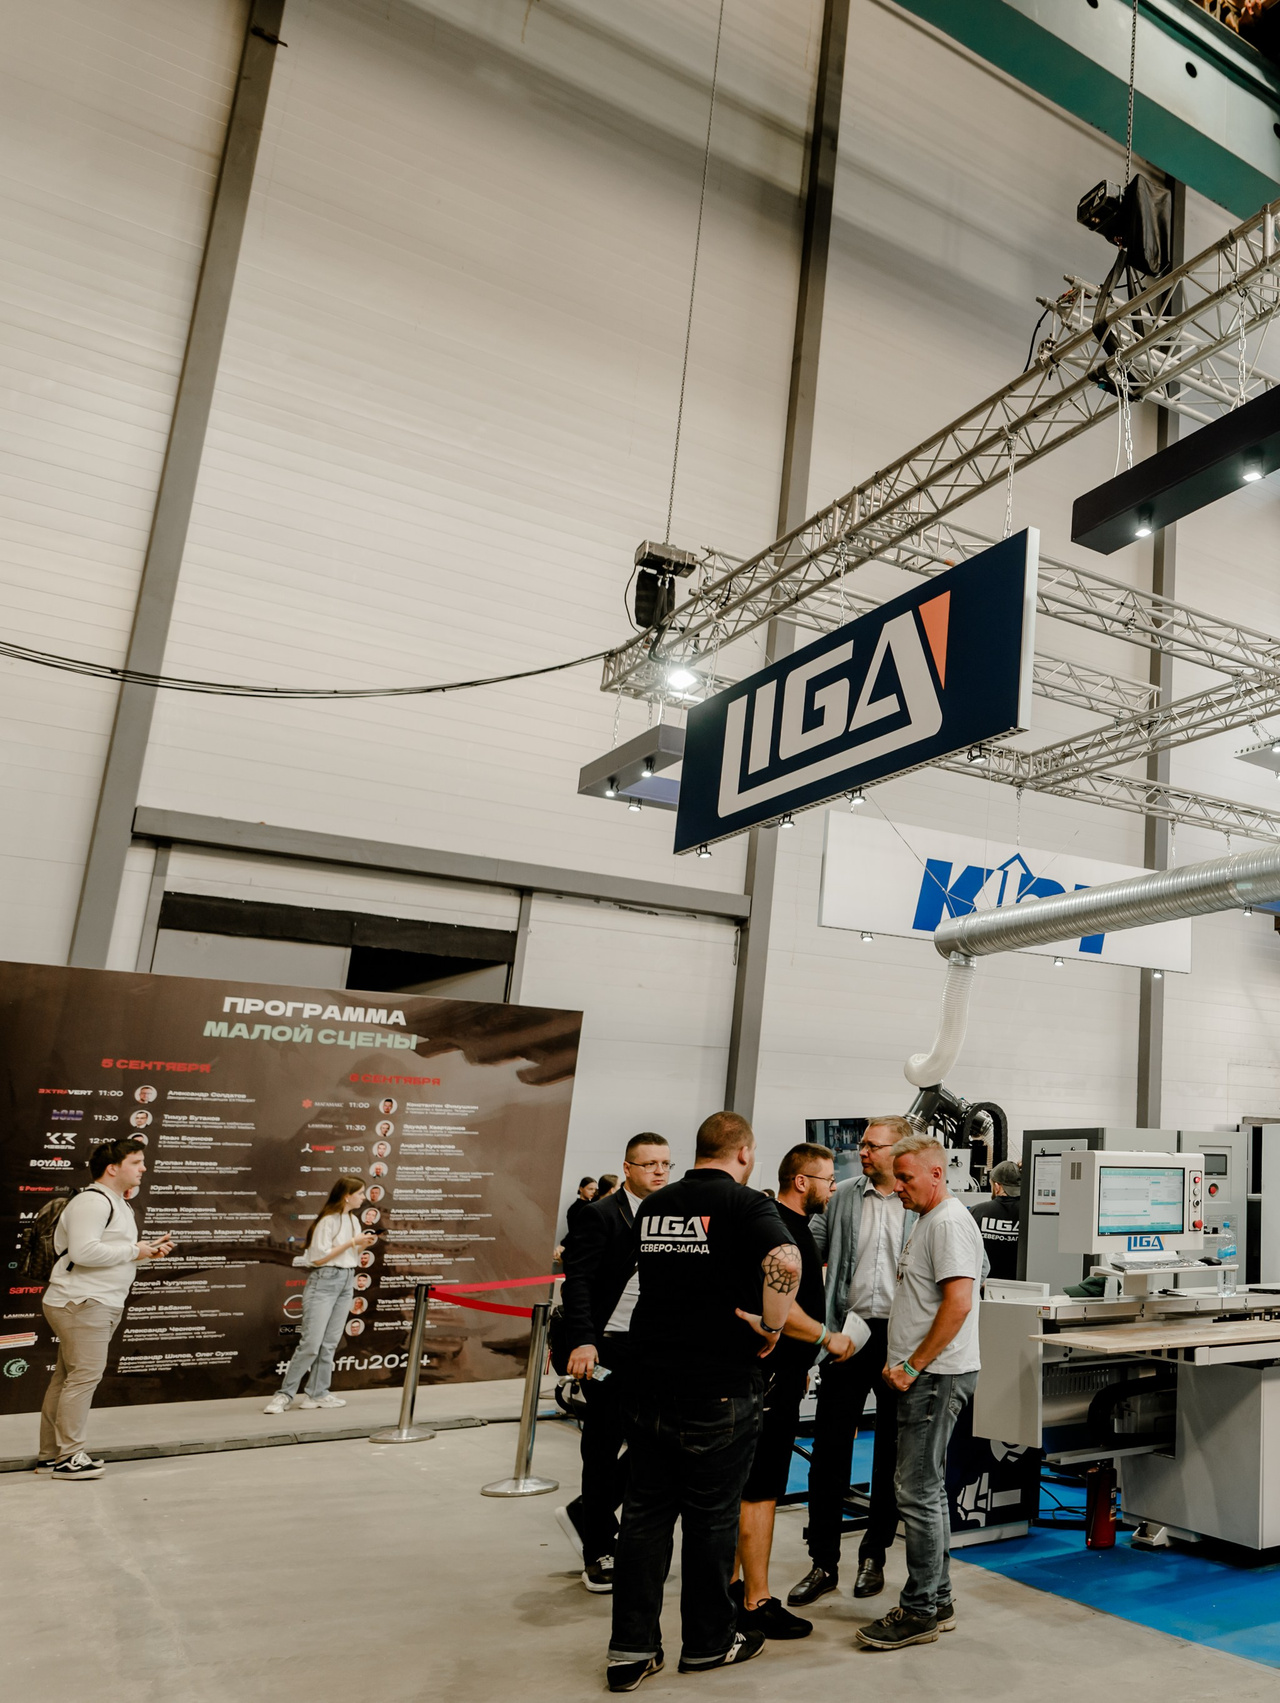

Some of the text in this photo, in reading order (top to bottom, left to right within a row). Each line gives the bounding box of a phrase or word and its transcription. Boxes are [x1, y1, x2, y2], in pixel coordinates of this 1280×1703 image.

[717, 590, 951, 819] LIGA
[222, 996, 407, 1026] ПРОГРАММА
[203, 1020, 417, 1050] МАЛОЙ СЦЕНЫ
[101, 1058, 211, 1073] 5 СЕНТЯБРЯ
[349, 1073, 441, 1086] 6 СЕНТЯБРЯ
[29, 1159, 71, 1167] BOYARD
[640, 1215, 711, 1241] LIGA
[640, 1243, 710, 1255] СЕВЕРО-ЗАПАД
[1127, 1235, 1165, 1251] LIGA
